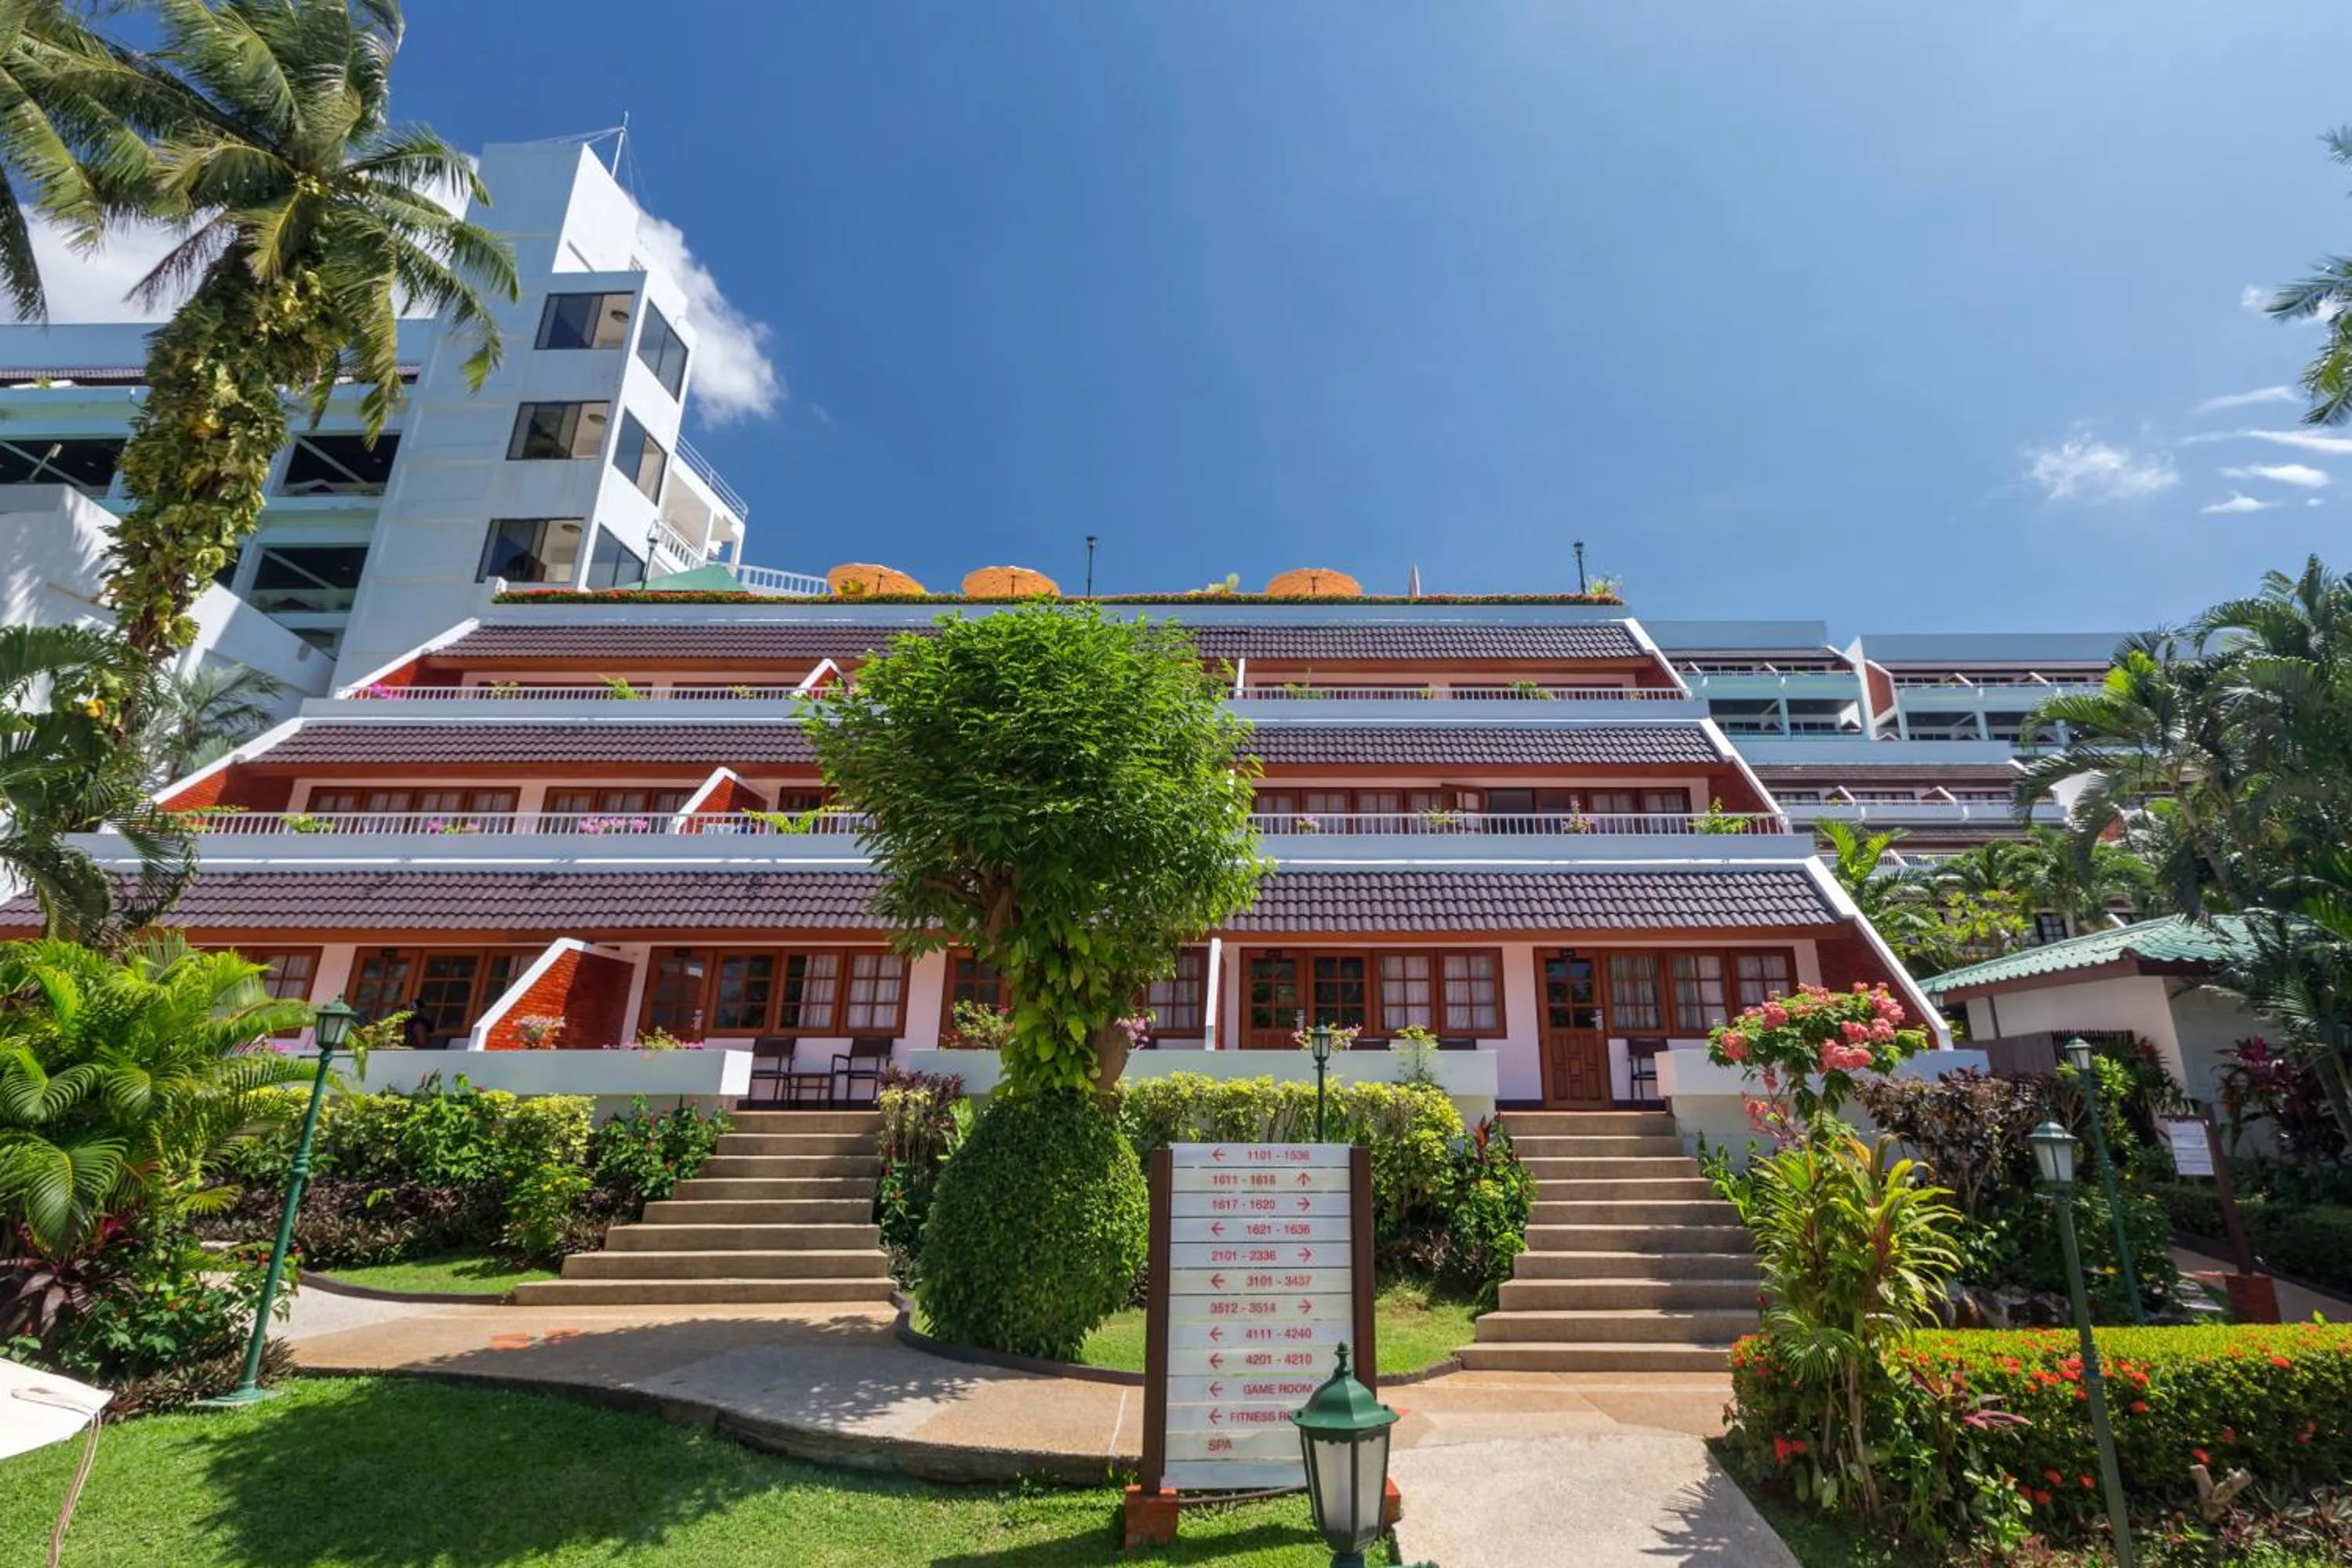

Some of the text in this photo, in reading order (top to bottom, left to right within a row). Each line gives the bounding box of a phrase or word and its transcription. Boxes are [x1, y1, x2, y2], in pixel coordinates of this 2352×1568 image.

[1243, 1383, 1313, 1394] GAME ROOM
[1230, 1411, 1276, 1421] FITNESS
[1208, 1439, 1232, 1450] SPA
